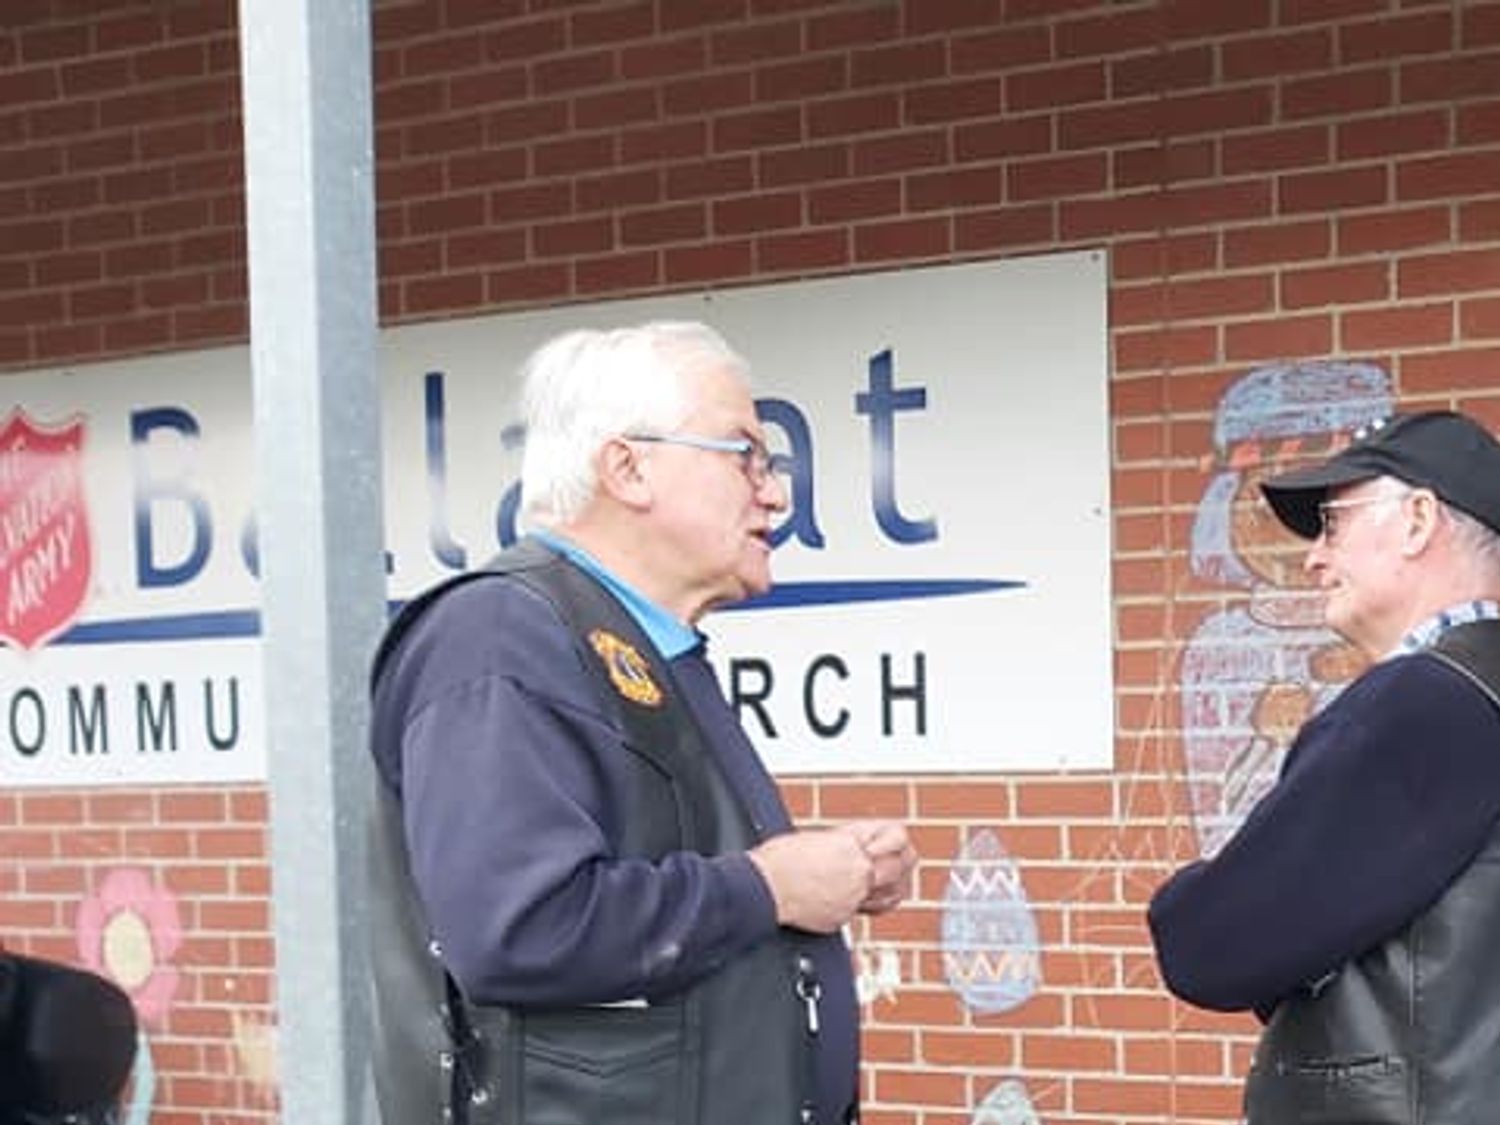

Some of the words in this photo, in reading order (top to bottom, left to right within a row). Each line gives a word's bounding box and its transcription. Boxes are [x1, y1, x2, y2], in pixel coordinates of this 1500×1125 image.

[130, 349, 939, 590] Blat
[4, 508, 76, 628] ARMY
[729, 650, 928, 740] RCH
